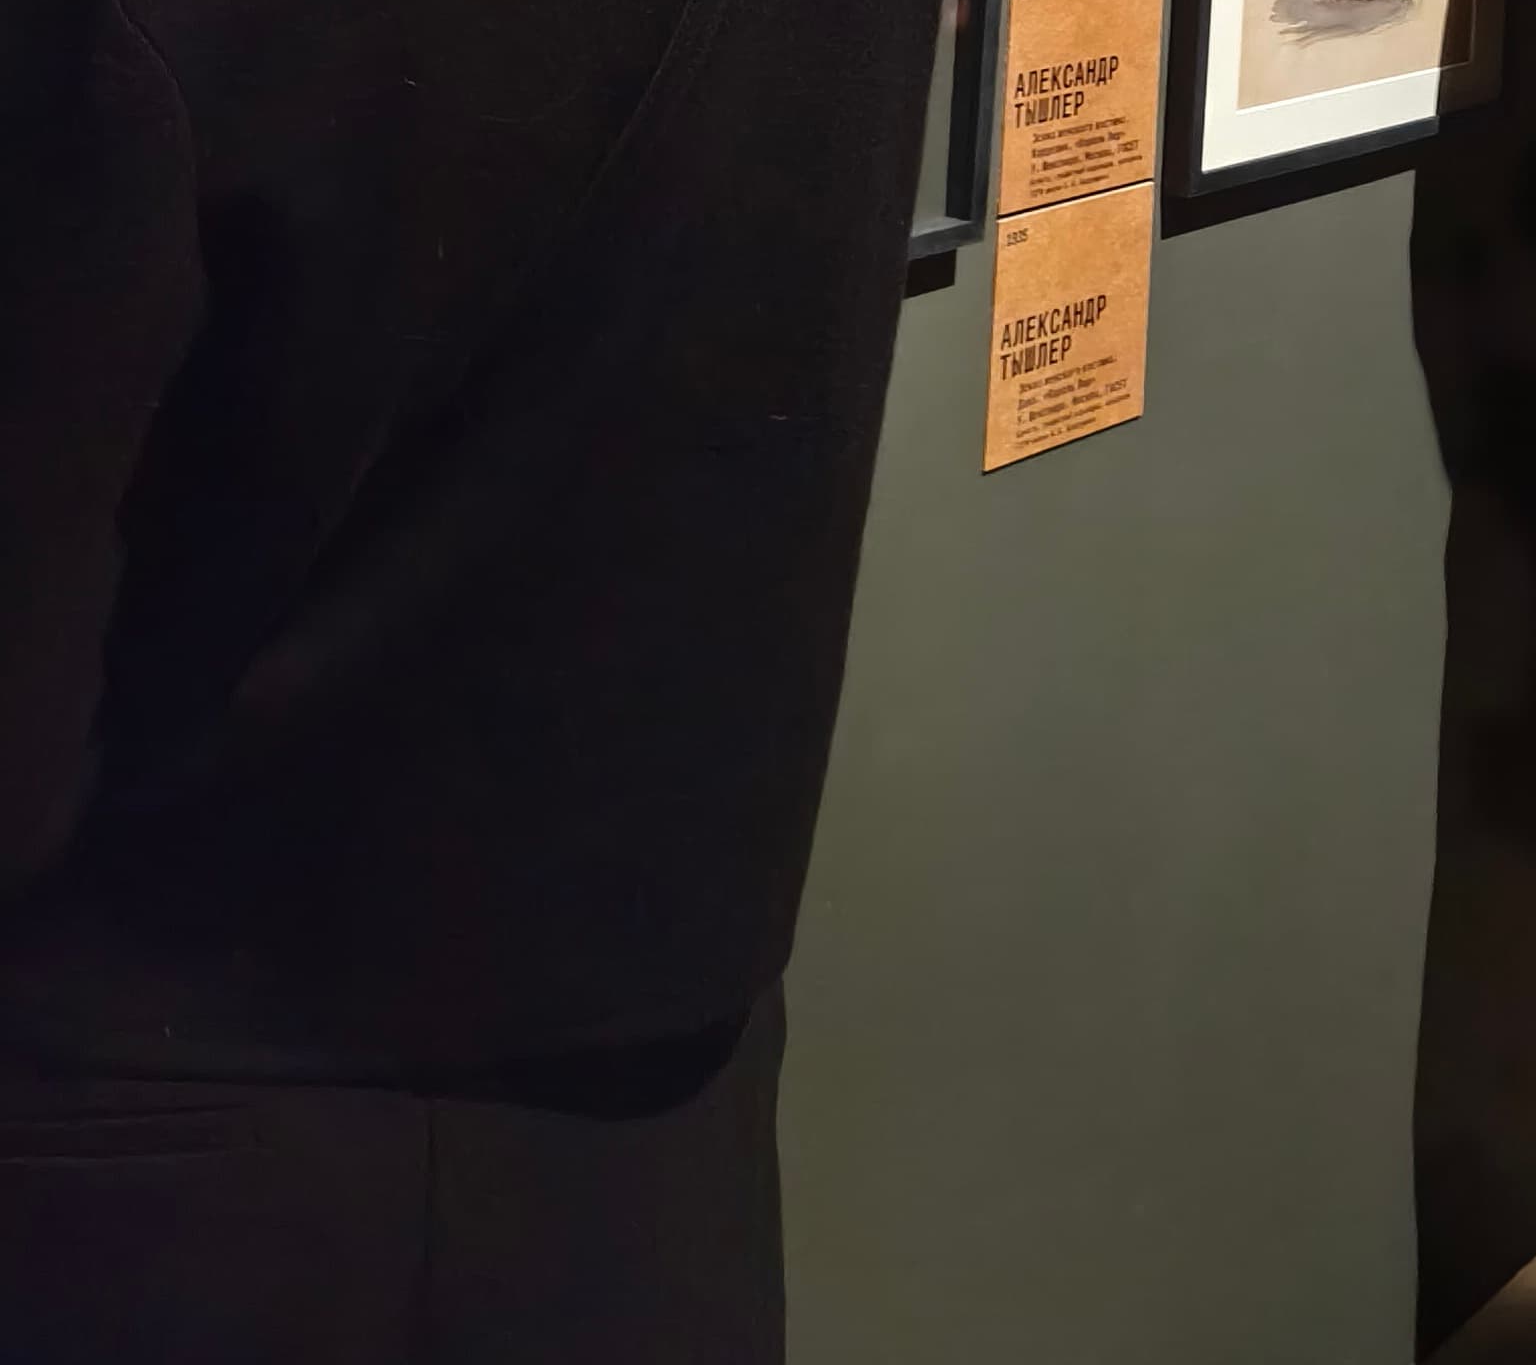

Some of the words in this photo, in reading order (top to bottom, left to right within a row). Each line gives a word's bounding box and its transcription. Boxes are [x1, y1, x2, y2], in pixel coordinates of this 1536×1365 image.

[1013, 55, 1120, 99] АЛЕКСАНДР
[1014, 91, 1085, 129] ТЫШЛЕР
[1000, 294, 1107, 350] АЛЕКСАНДР
[999, 335, 1072, 381] ТЫШЛЕР
